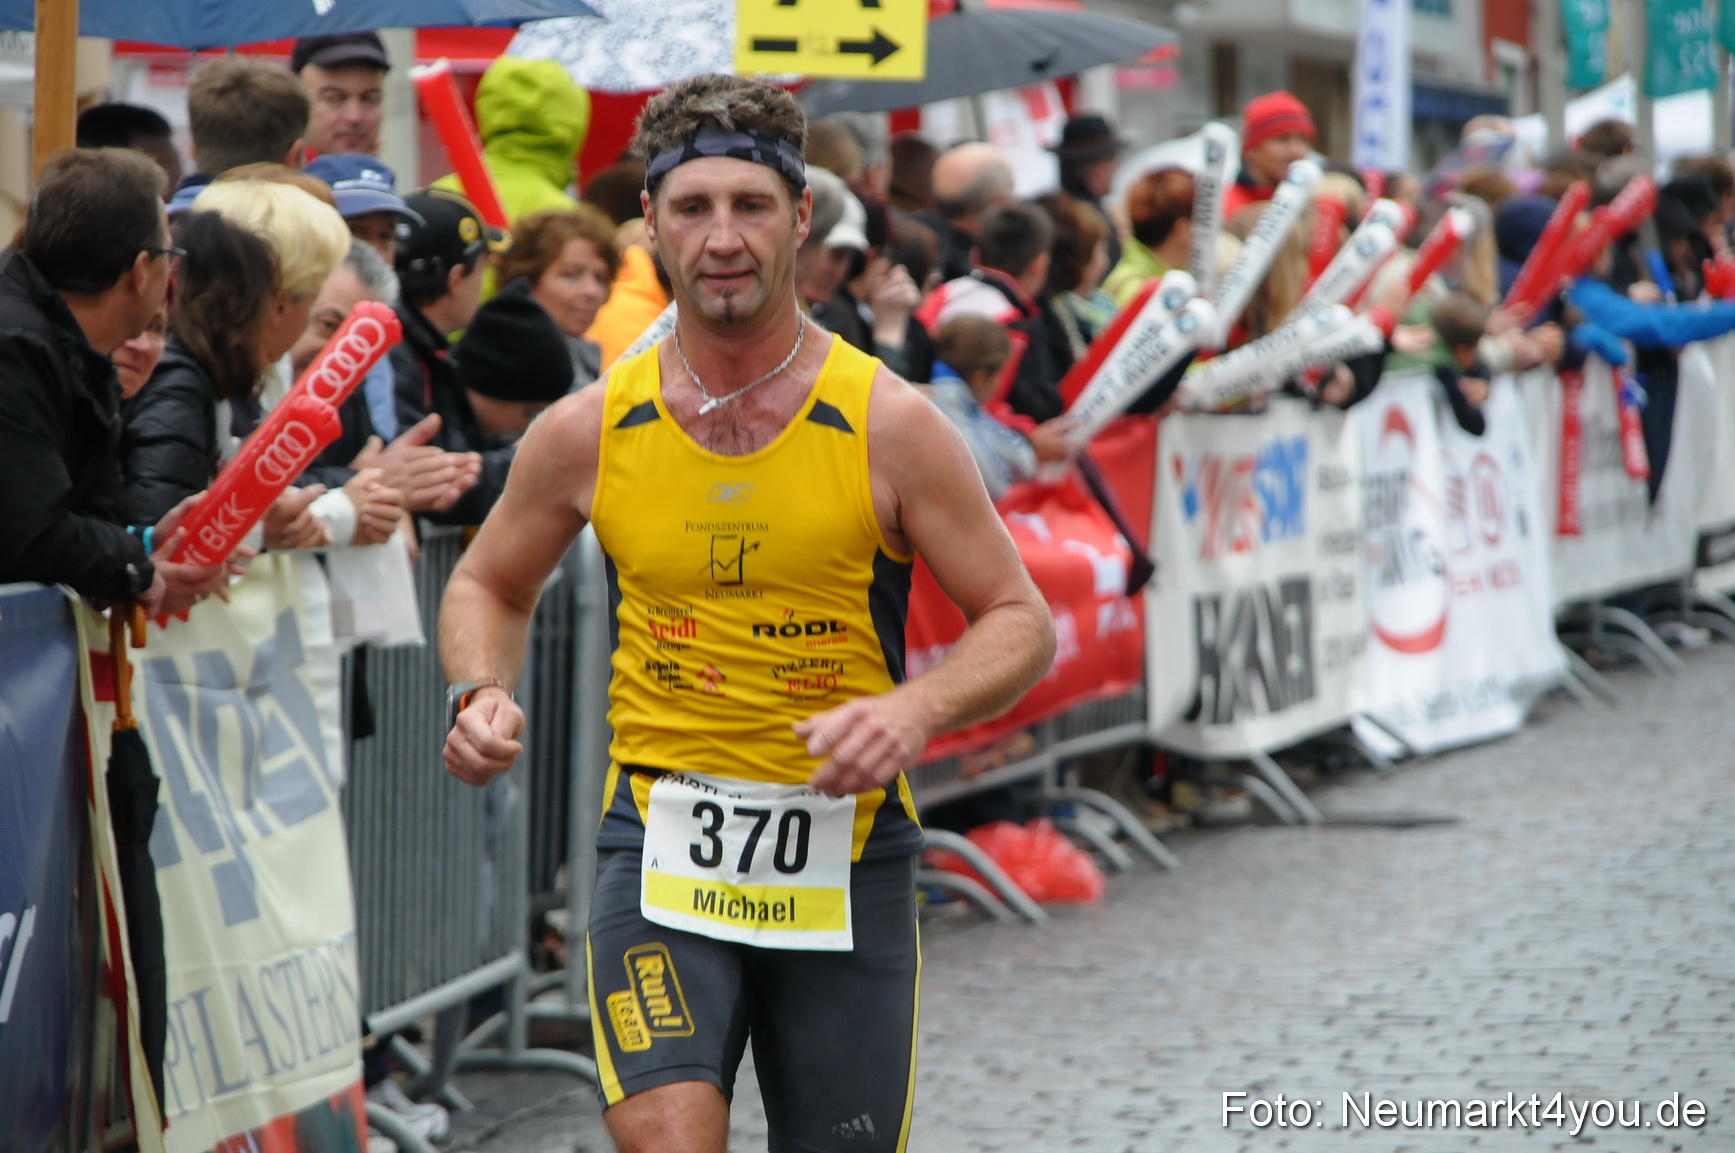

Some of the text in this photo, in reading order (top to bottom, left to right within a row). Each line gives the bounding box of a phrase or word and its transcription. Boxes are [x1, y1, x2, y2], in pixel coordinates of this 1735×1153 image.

[198, 490, 256, 551] BKK
[648, 617, 697, 641] Seidl
[689, 800, 811, 874] 370
[692, 887, 796, 923] Michael
[634, 952, 684, 1028] Run!
